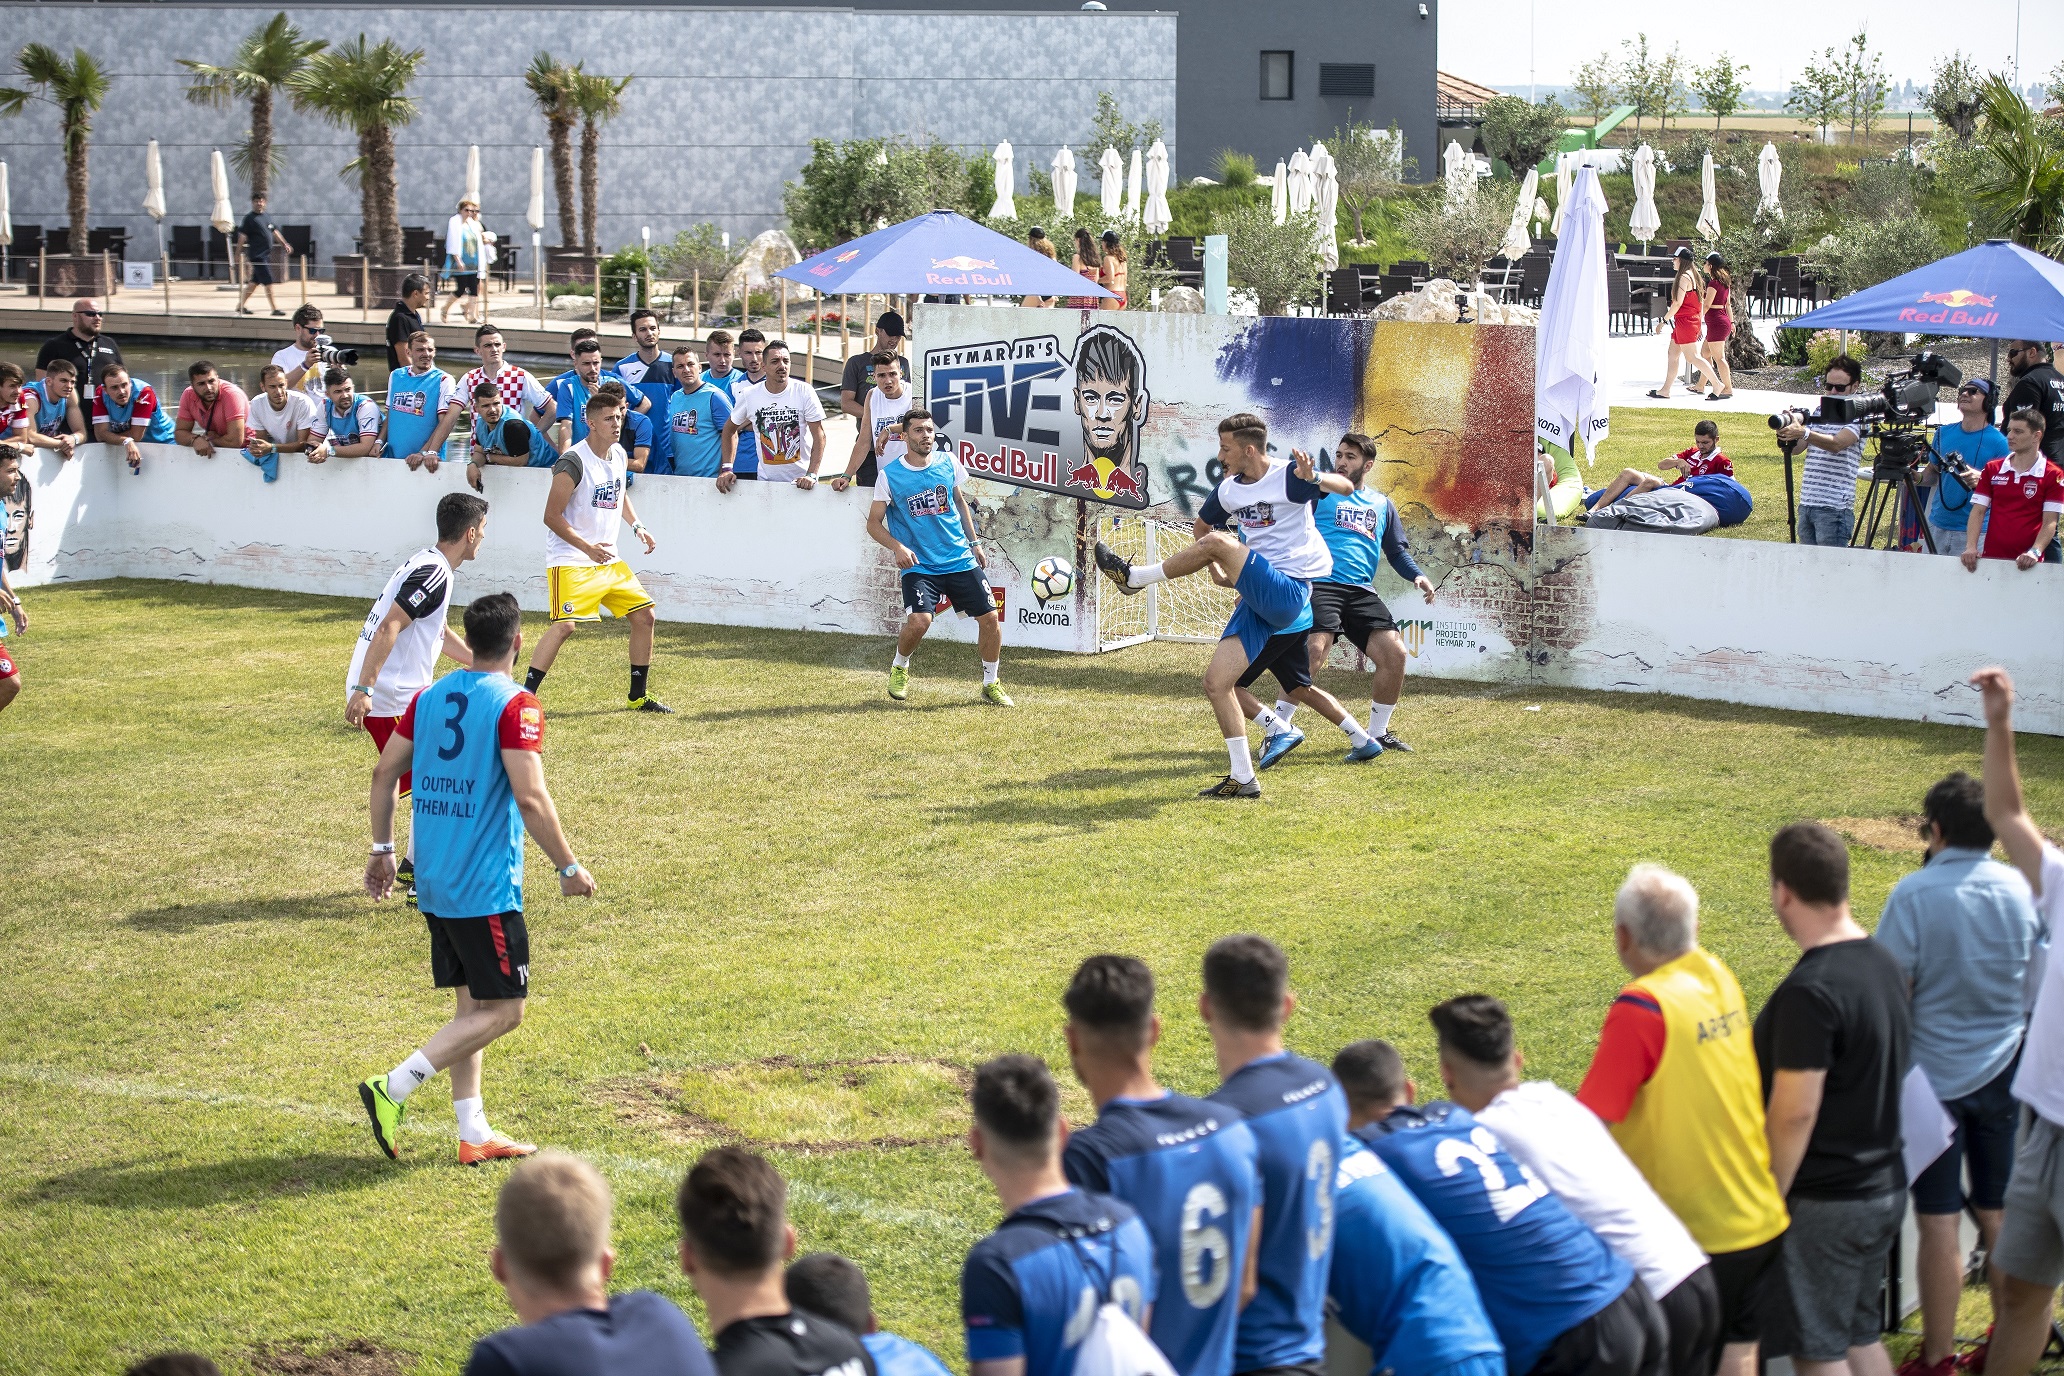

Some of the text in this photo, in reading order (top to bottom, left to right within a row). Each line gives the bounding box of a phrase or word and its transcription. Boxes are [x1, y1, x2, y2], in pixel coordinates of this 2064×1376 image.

[926, 272, 1013, 286] Red Bull
[1898, 307, 2000, 327] Red Bull
[930, 341, 1054, 367] NEYMAR JR'S
[930, 360, 1067, 447] FIVE
[958, 440, 1058, 487] Red Bull
[1046, 603, 1067, 611] MEN
[1018, 608, 1070, 627] Rexona
[1436, 621, 1477, 632] INSTITUTO
[1435, 630, 1468, 640] PROJETO
[1435, 638, 1476, 649] NEYMAR JR
[437, 691, 469, 762] 3
[421, 776, 476, 796] OUTPLAY
[415, 798, 477, 819] THEM ALL!
[1306, 1138, 1334, 1262] 3
[1180, 1182, 1231, 1310] 6
